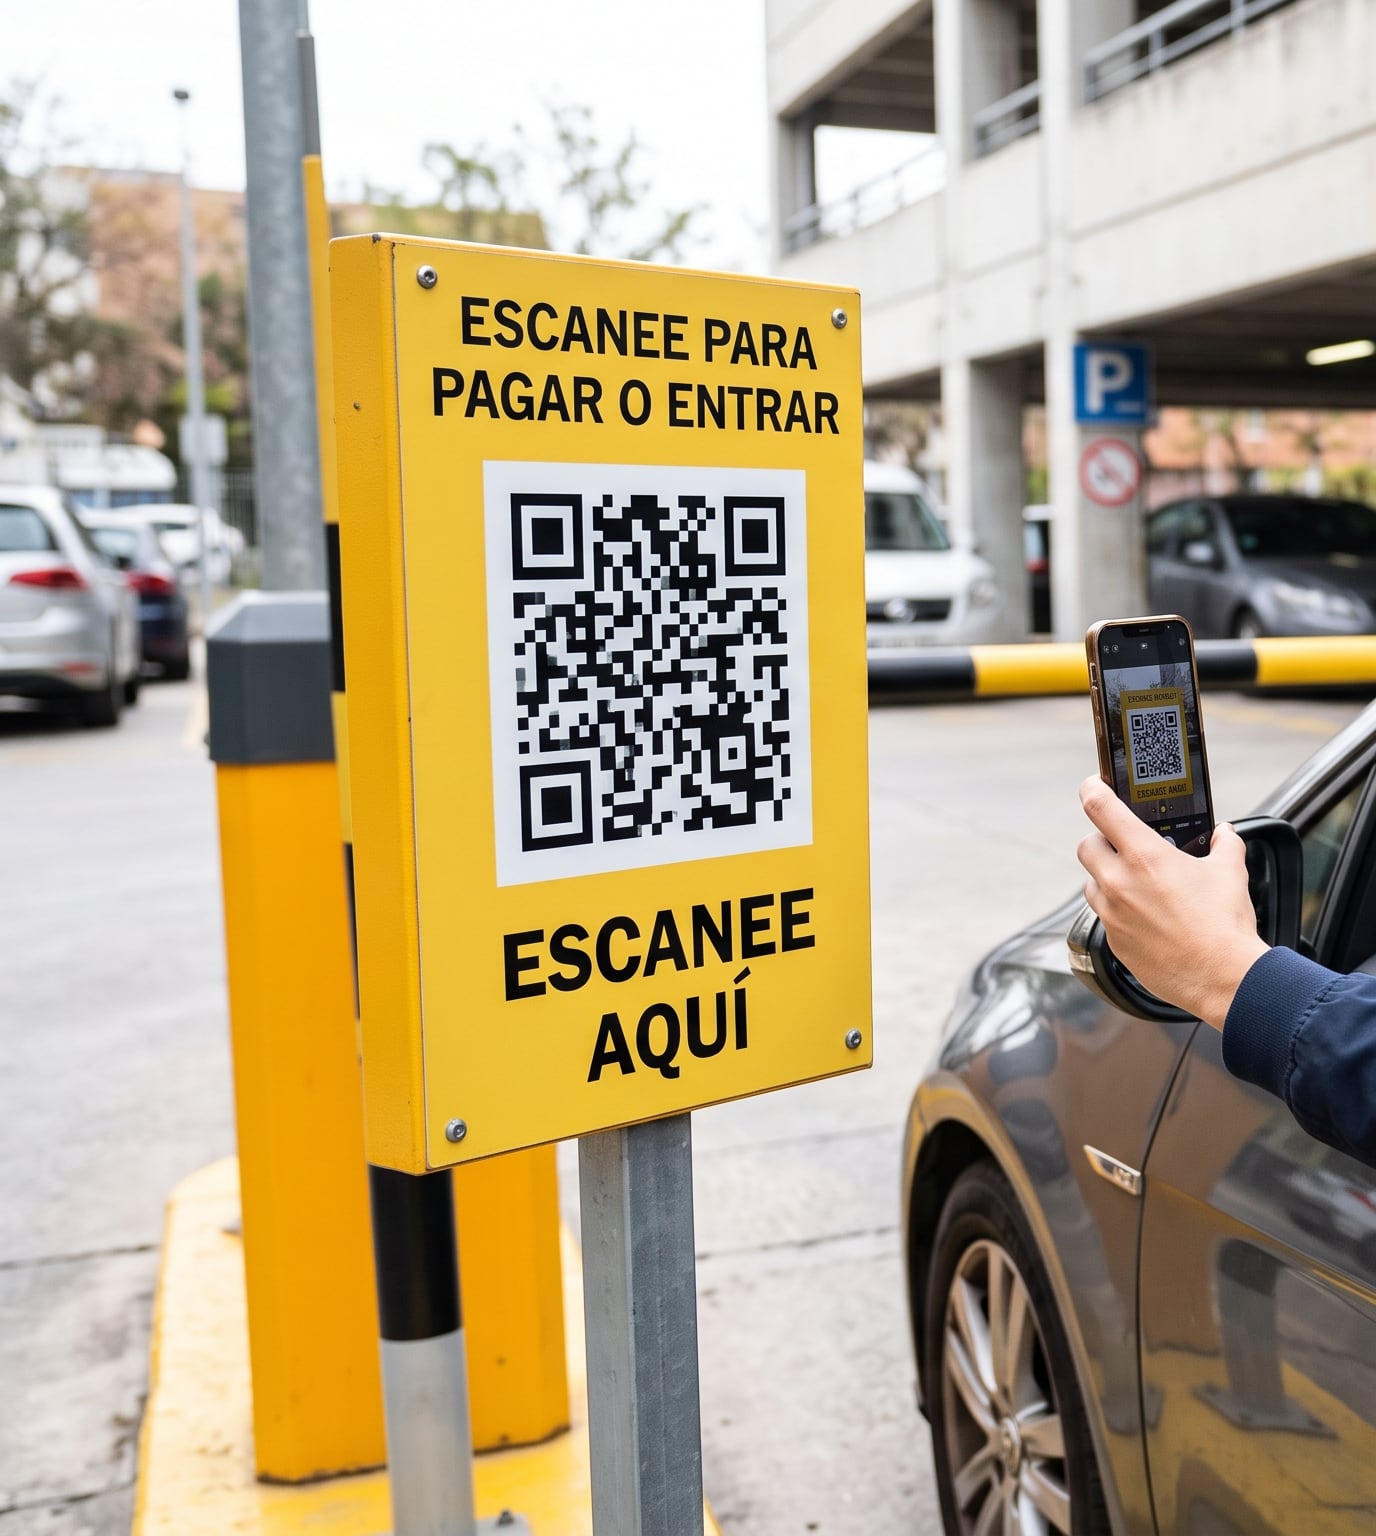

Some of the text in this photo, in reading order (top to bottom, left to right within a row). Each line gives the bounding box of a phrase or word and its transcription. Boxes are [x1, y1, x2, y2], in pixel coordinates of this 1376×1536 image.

[461, 295, 818, 370] ESCANEE PARA
[432, 367, 840, 435] PAGAR O ENTRAR
[1085, 351, 1133, 413] P
[503, 887, 816, 1002] ESCANEE
[587, 966, 751, 1083] AQUÍ
